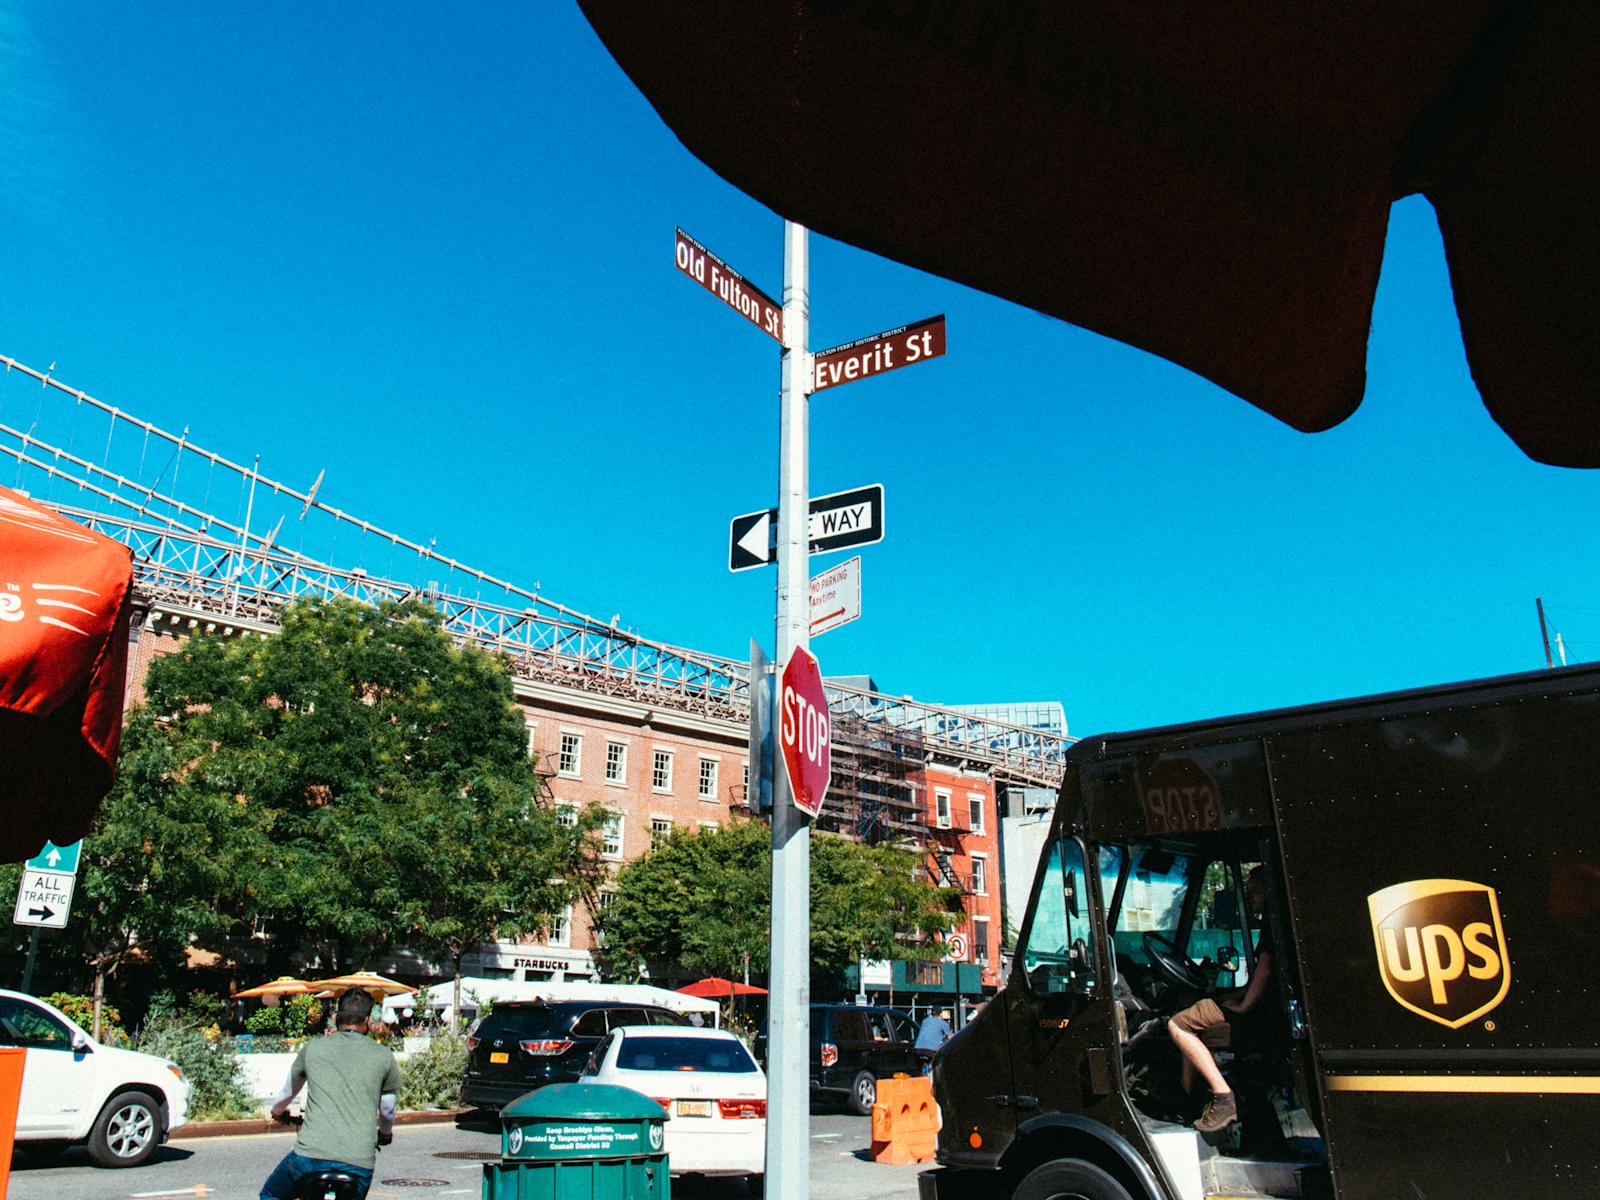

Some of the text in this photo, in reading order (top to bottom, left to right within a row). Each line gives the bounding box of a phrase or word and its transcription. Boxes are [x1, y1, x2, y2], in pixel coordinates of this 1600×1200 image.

[676, 241, 780, 338] Old Fulton St
[881, 326, 907, 338] DISTRICT
[815, 330, 932, 388] Everit St
[822, 506, 864, 534] WAY
[811, 569, 847, 594] NO PARKING
[784, 686, 828, 767] STOP
[35, 877, 60, 890] ALL
[24, 891, 67, 904] TRAFFIC
[514, 959, 569, 970] STARBUCKS
[546, 1127, 562, 1135] Keep
